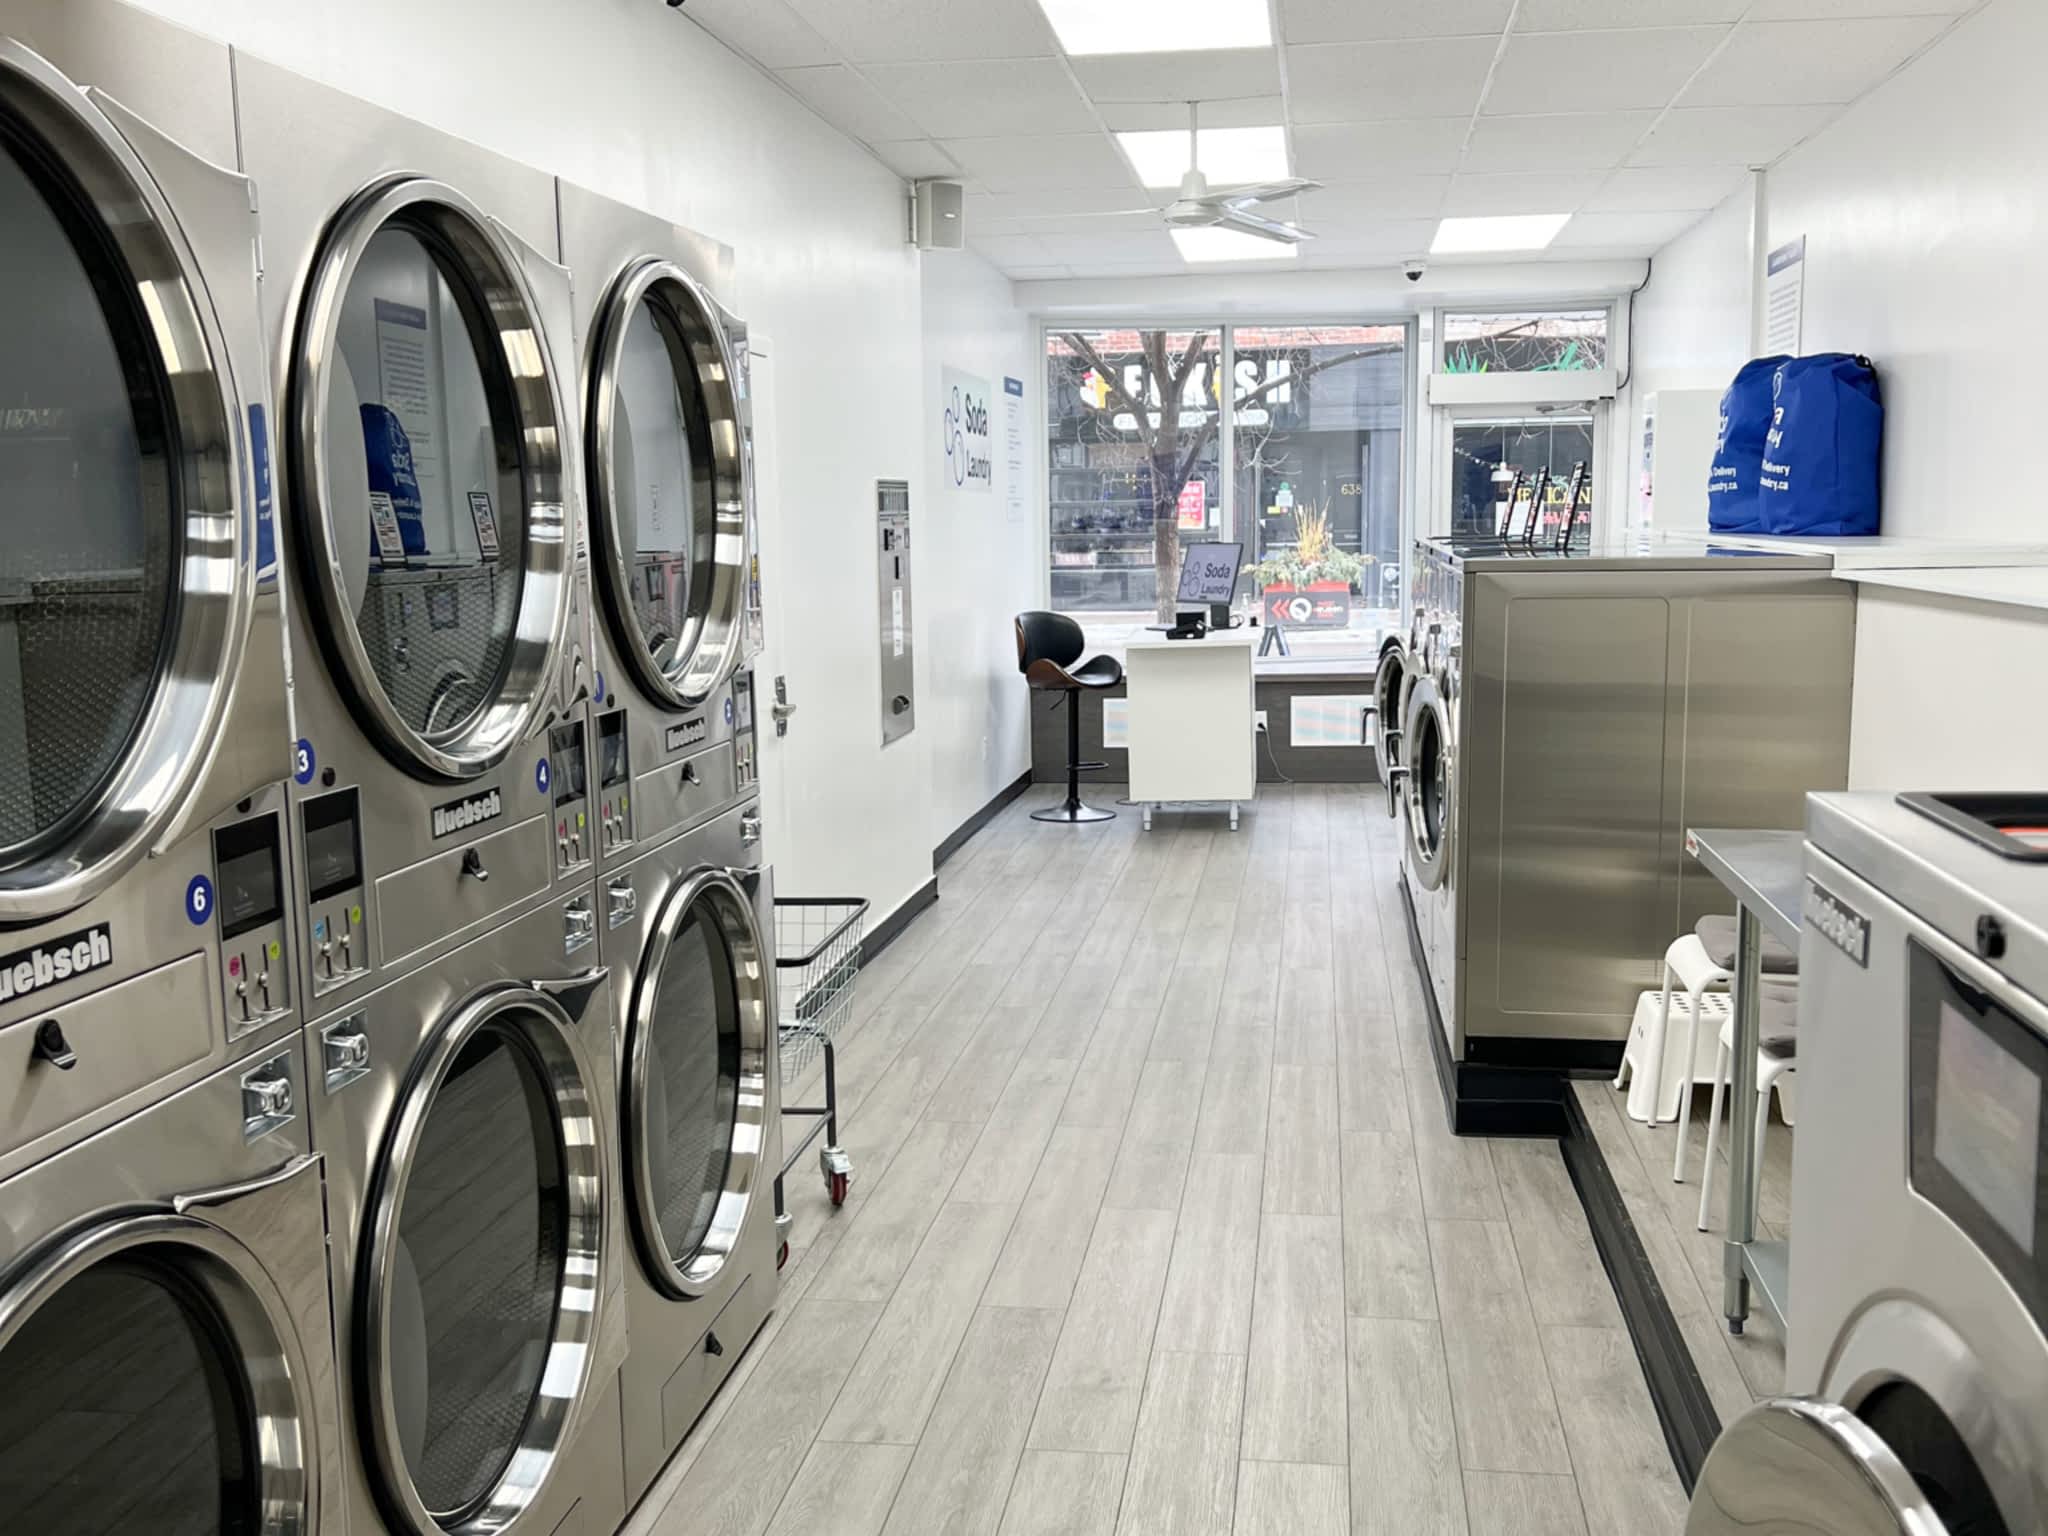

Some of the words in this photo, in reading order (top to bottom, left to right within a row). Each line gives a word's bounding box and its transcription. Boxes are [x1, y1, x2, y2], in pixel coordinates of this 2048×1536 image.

[965, 392, 988, 437] Soda
[966, 449, 992, 486] Laundry
[1204, 562, 1231, 579] Soda
[1200, 582, 1230, 598] Laundry
[298, 749, 309, 773] 3
[538, 767, 547, 784] 4
[434, 790, 501, 837] Huebsch
[193, 886, 206, 913] 6
